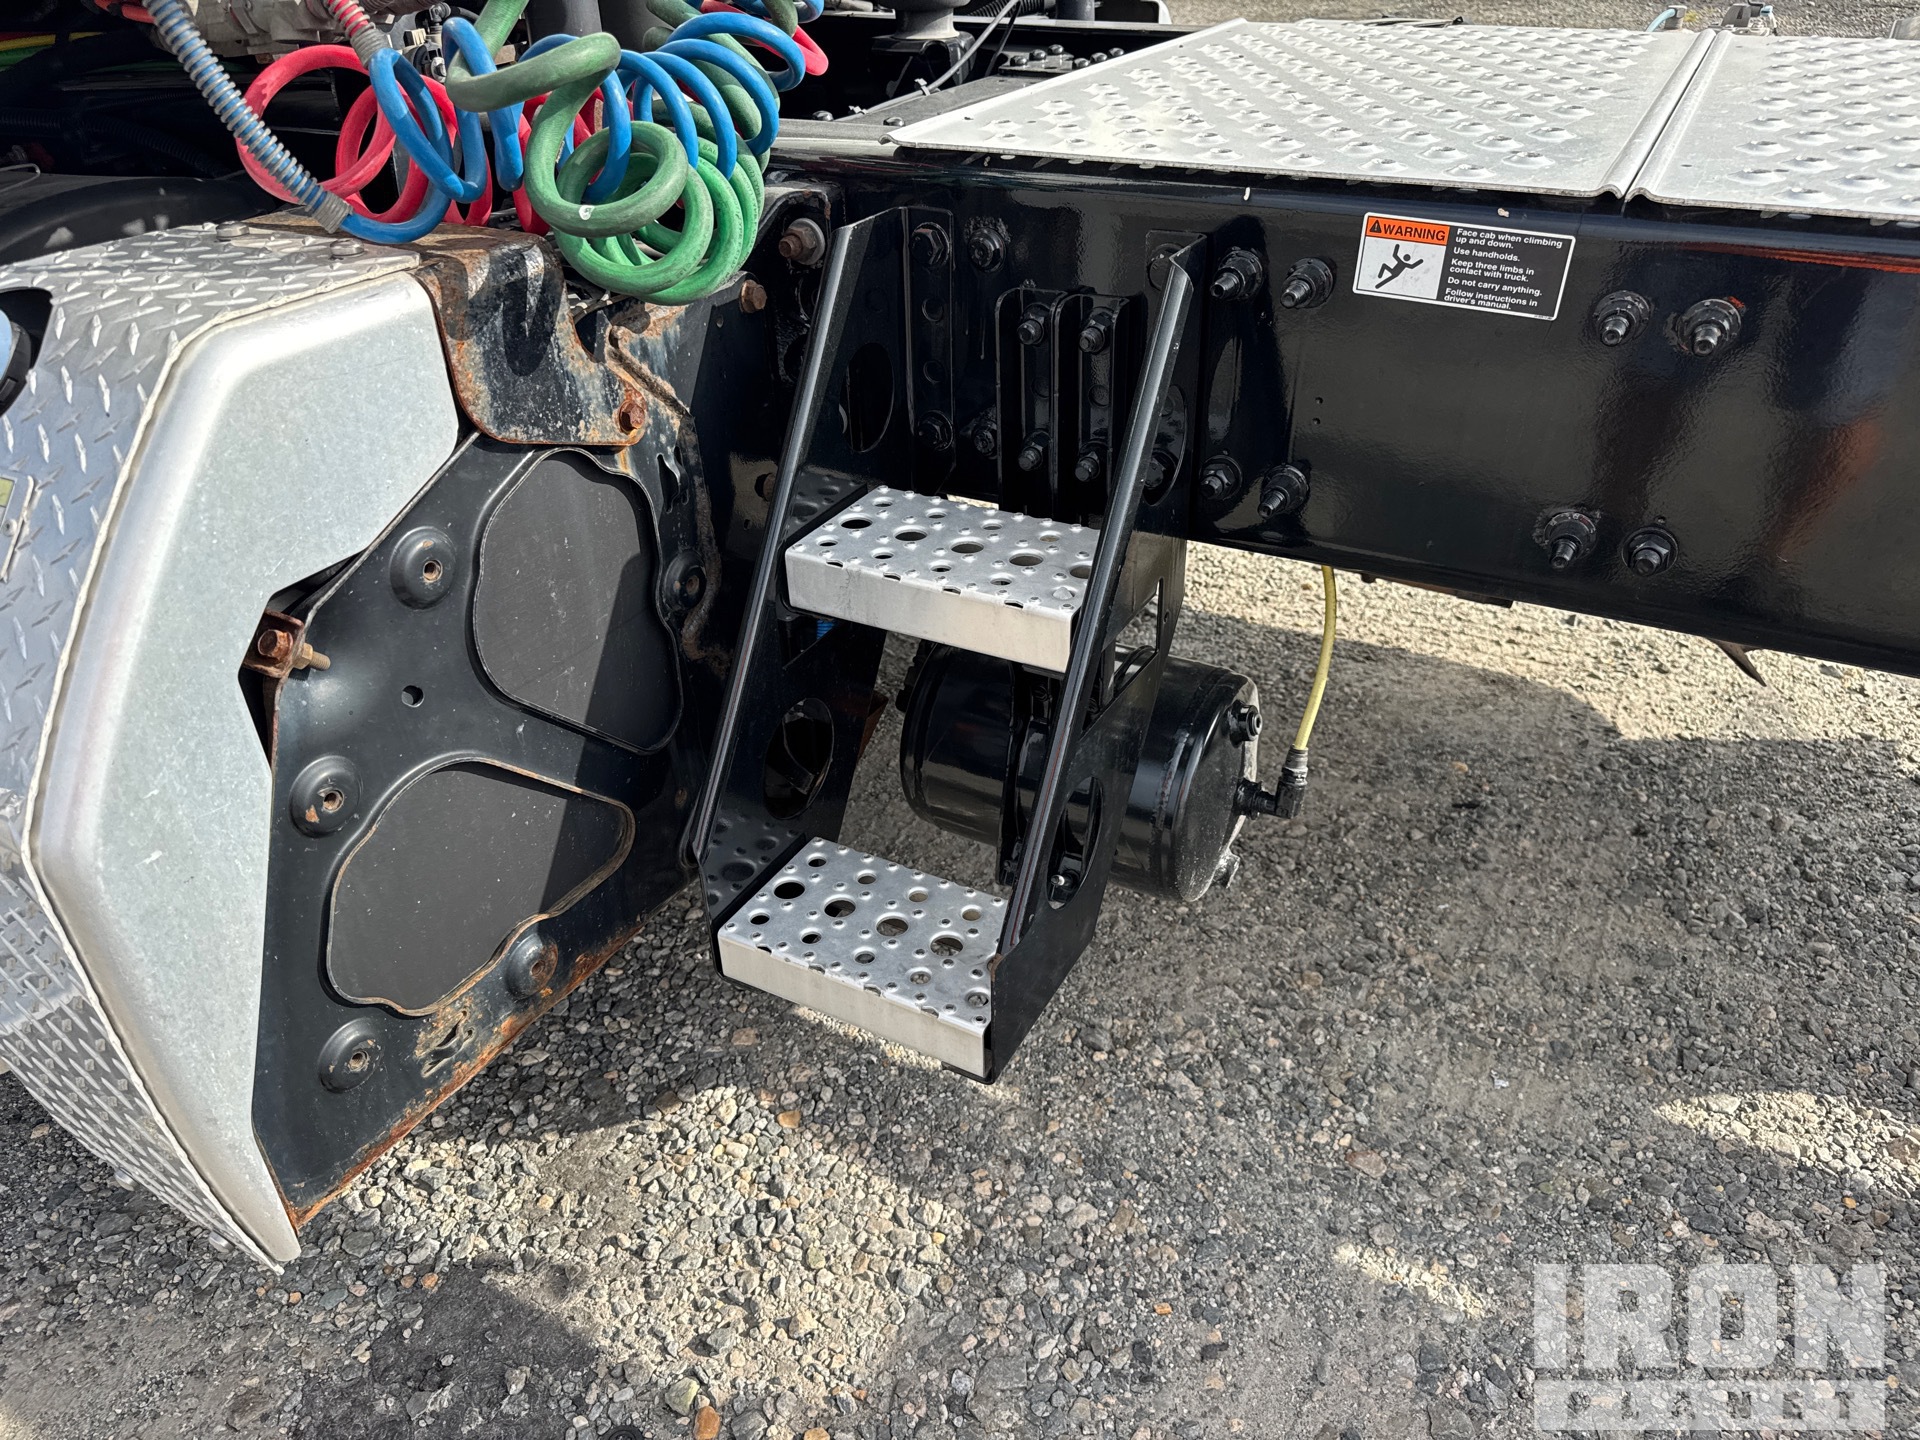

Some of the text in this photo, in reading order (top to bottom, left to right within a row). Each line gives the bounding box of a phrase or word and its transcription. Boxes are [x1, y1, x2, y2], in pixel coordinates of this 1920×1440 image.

[1383, 224, 1446, 242] WARNING
[1457, 228, 1563, 249] Face cab when climbing
[1455, 237, 1514, 249] up and down.
[1453, 247, 1520, 262] Use handholds.
[1449, 266, 1529, 282] contact with truck.
[1451, 258, 1535, 276] Keep three limbs in
[1447, 276, 1543, 297] Do not carry anything.
[1444, 295, 1511, 310] driver's manual.
[1445, 288, 1538, 307] Follow instructions in
